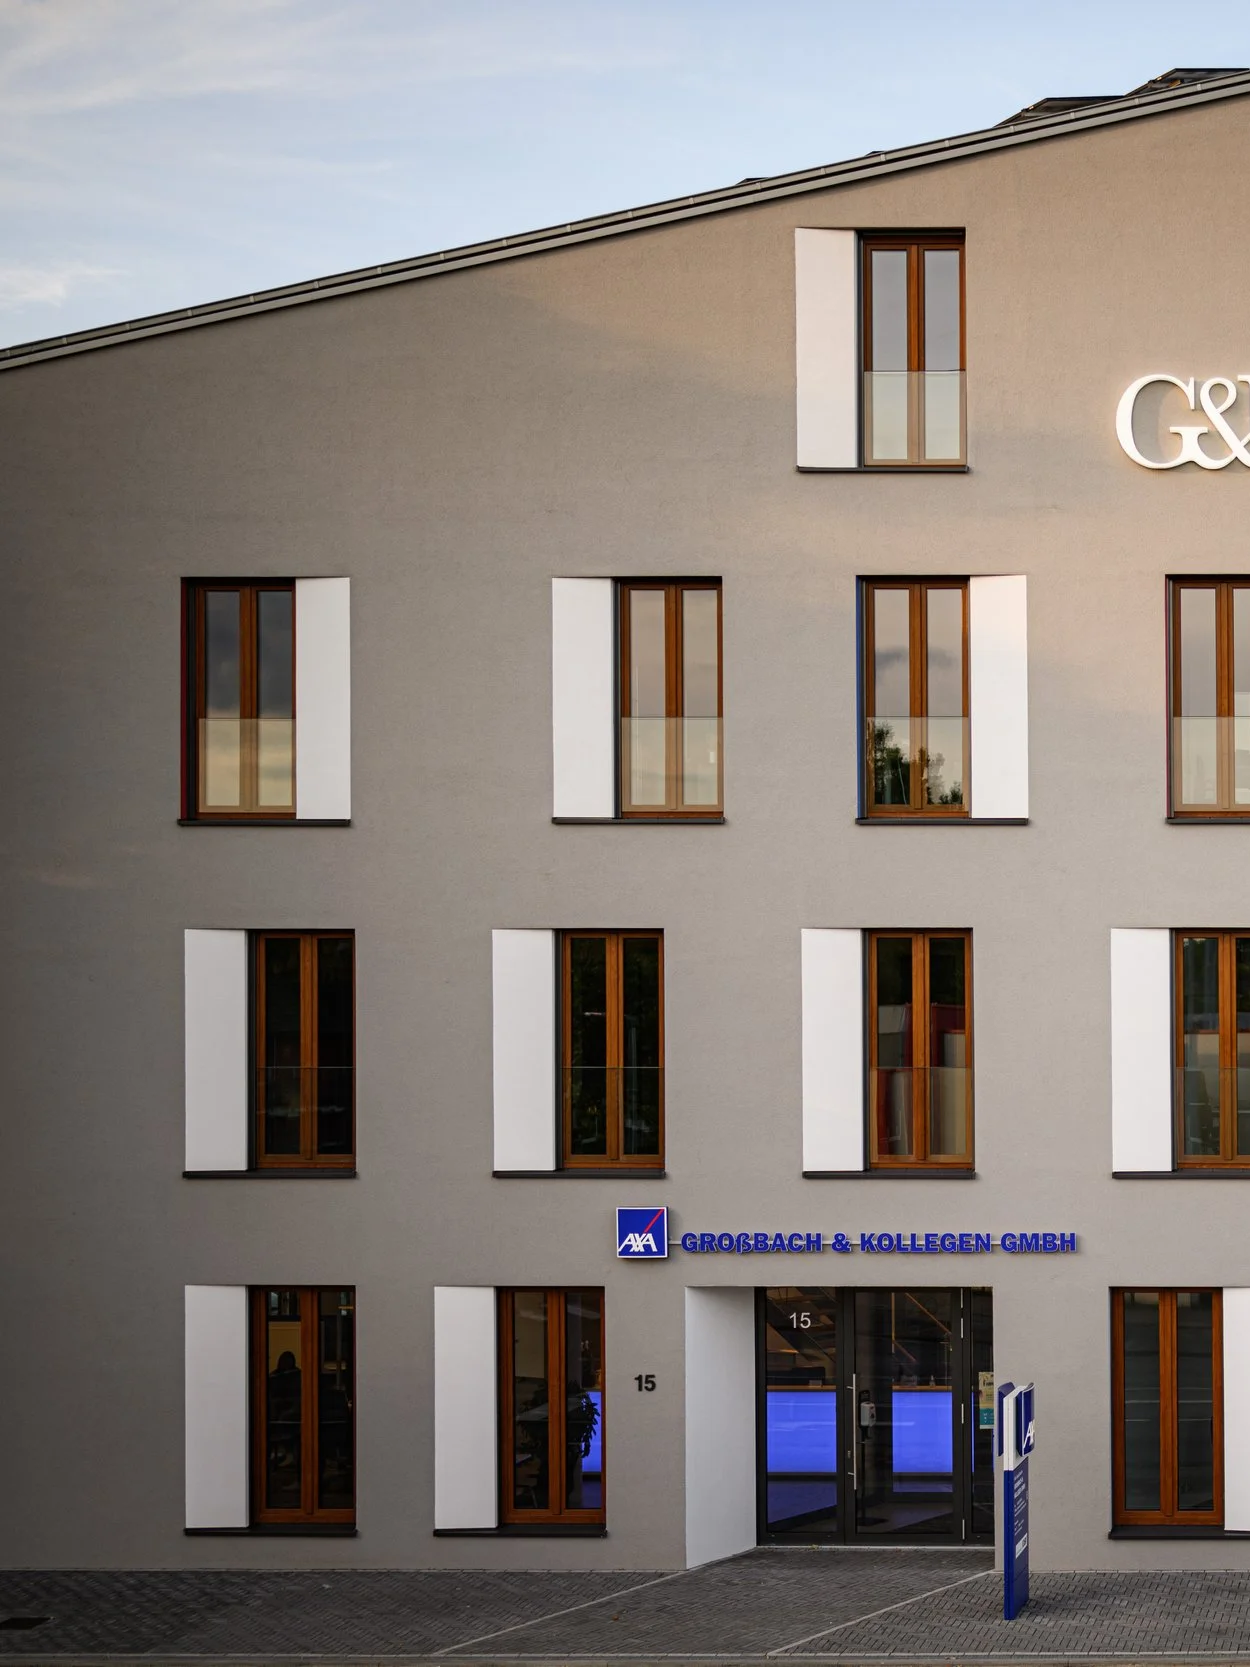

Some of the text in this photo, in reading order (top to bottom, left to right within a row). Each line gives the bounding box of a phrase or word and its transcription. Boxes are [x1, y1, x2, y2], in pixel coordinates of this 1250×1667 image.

[618, 1232, 658, 1253] AXA
[681, 1231, 1077, 1254] GROßBACH & KOLLEGEN GMBH
[789, 1312, 812, 1329] 15
[634, 1374, 657, 1392] 15
